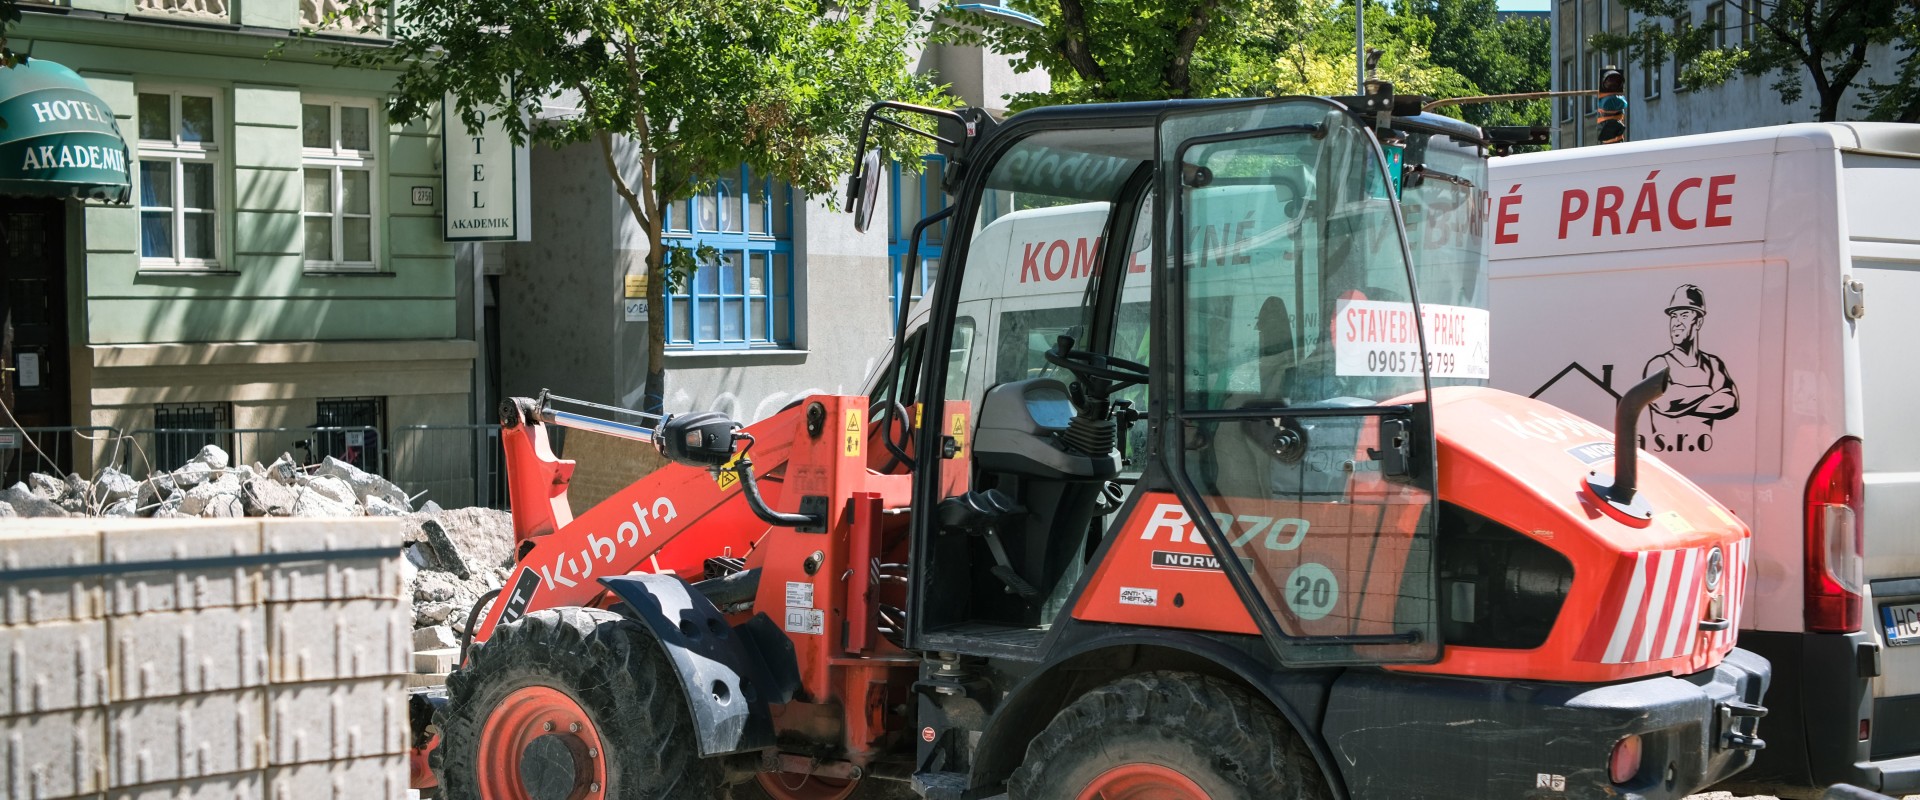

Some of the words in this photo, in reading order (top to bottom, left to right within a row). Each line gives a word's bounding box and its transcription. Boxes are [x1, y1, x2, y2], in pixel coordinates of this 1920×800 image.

[32, 100, 108, 124] HOTEL
[1558, 170, 1736, 240] PRÁCE
[451, 218, 509, 229] AKADEMIK
[1434, 308, 1466, 346] PRÁCE
[1367, 350, 1406, 372] 0905
[1436, 353, 1455, 374] 799
[1653, 433, 1713, 452] s.r.o
[1140, 503, 1310, 551] R070
[541, 496, 677, 591] Kubota
[1293, 575, 1330, 609] 20
[1893, 608, 1918, 635] HC
